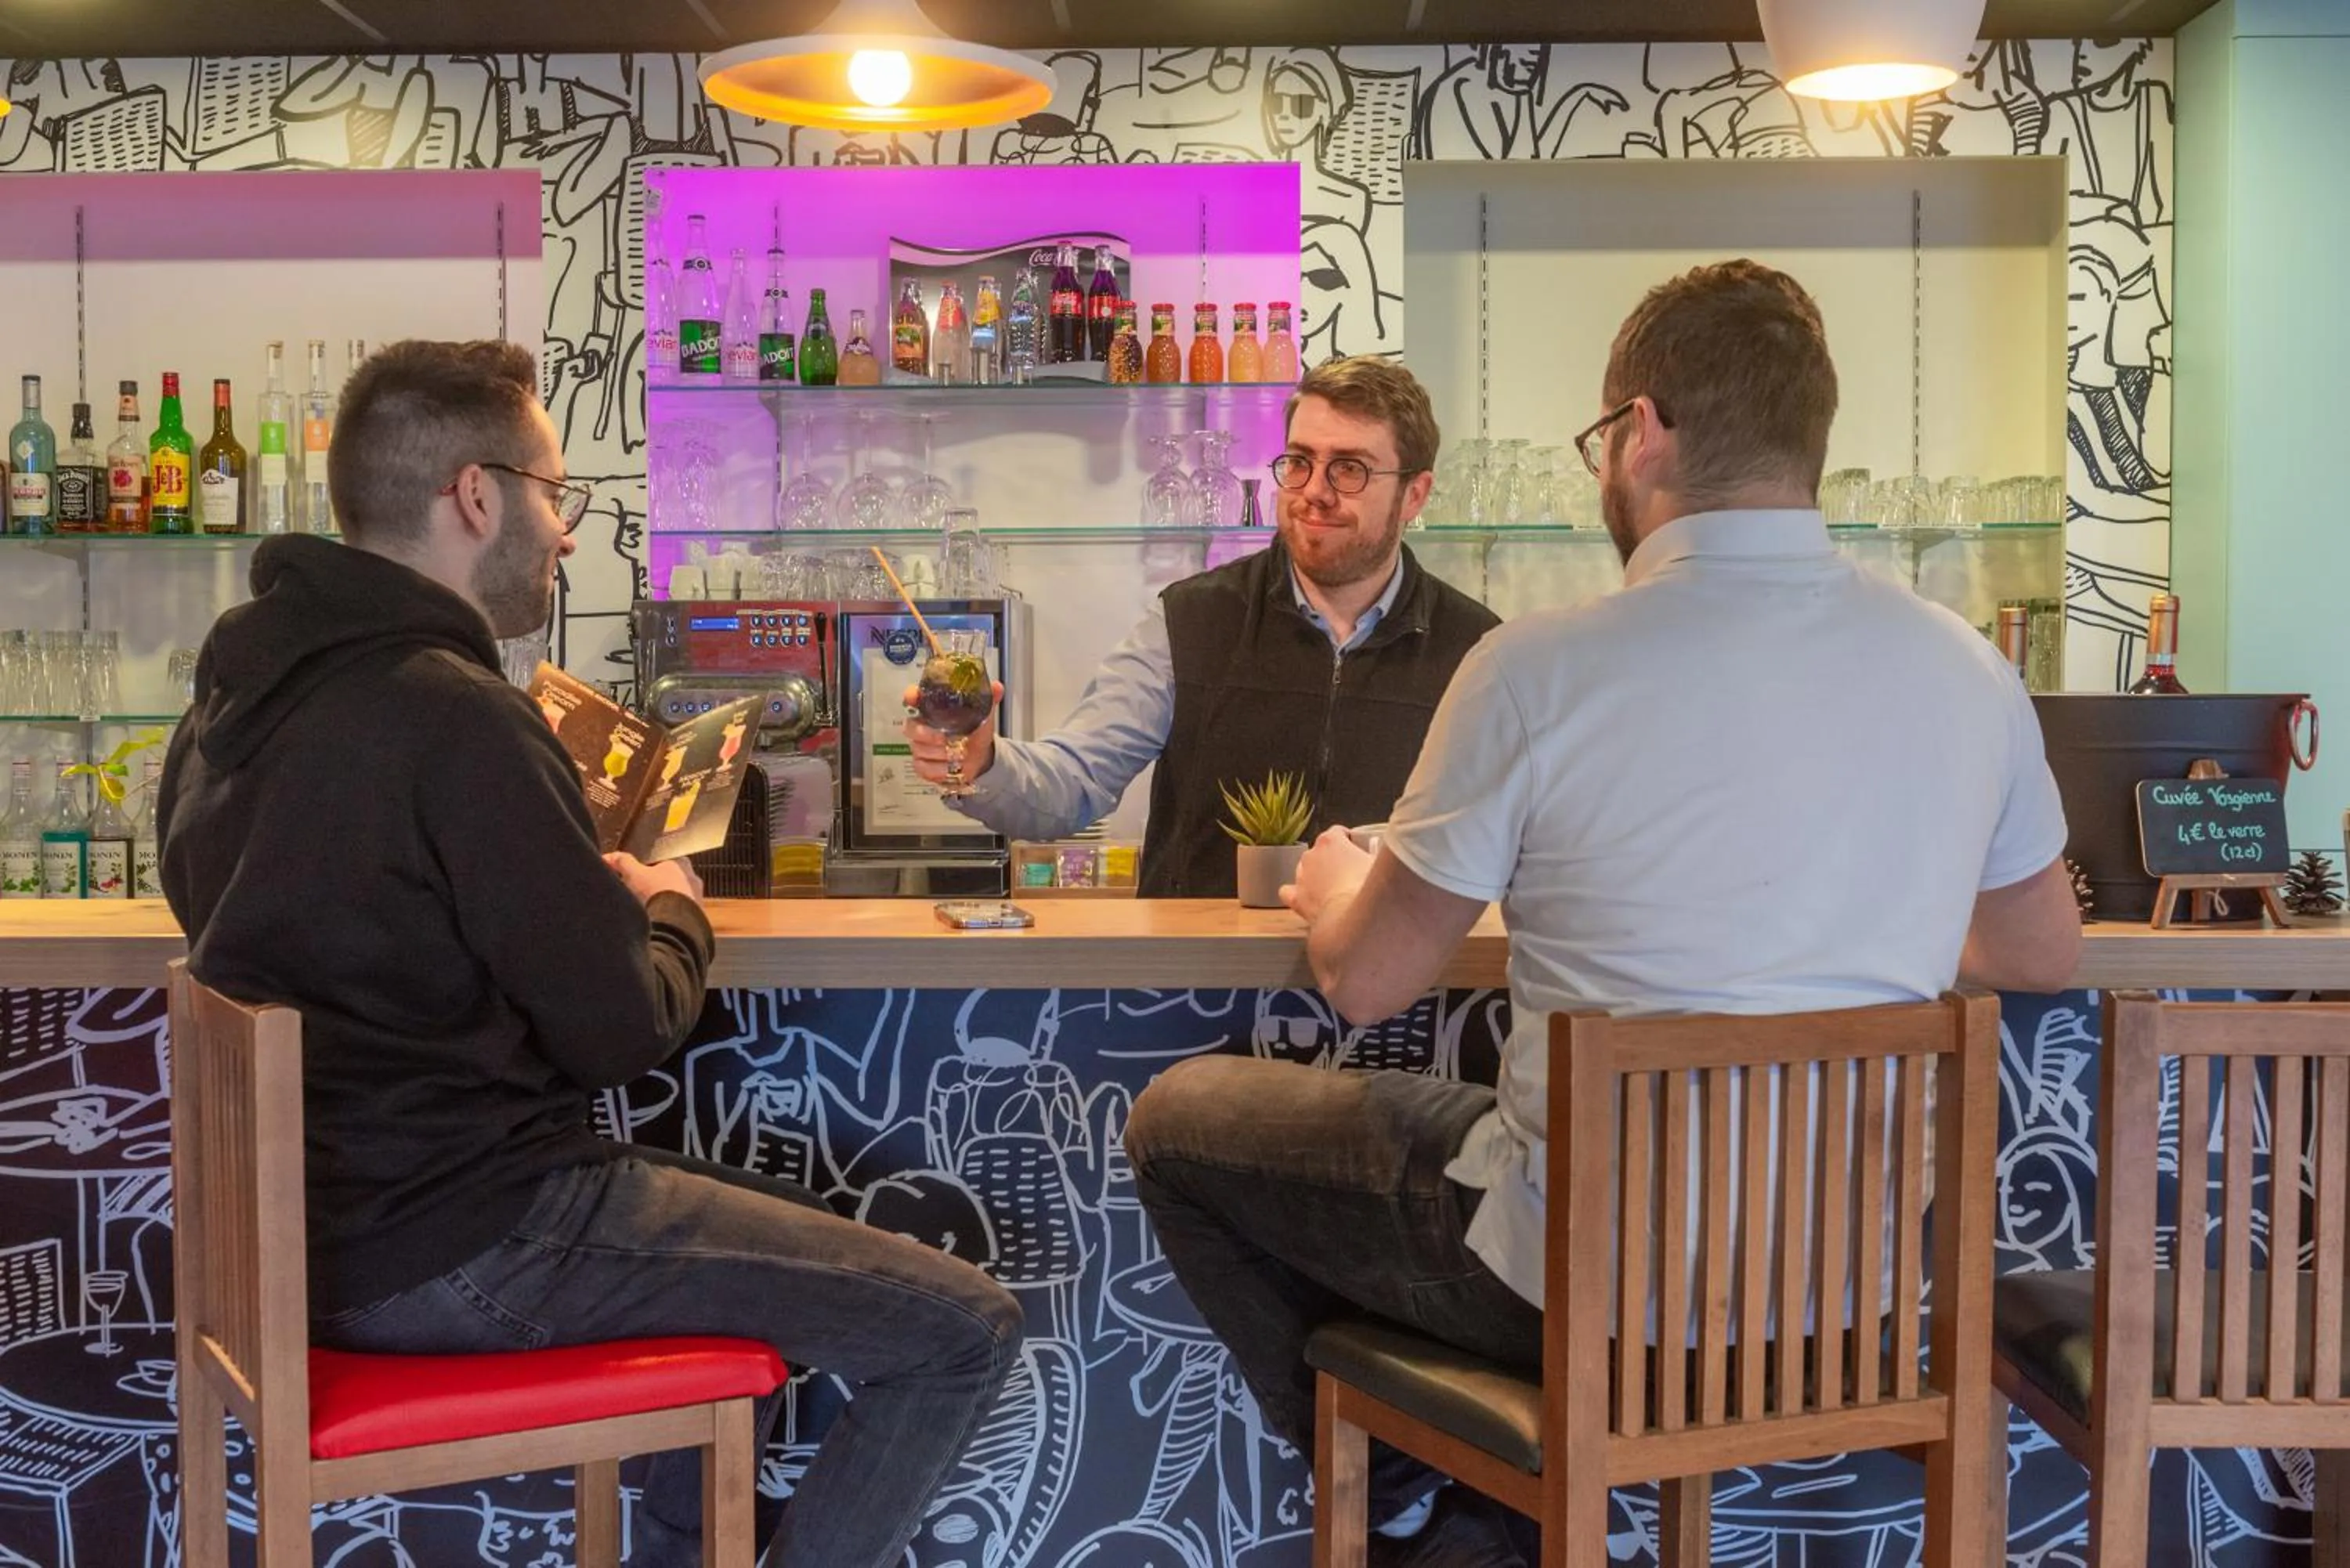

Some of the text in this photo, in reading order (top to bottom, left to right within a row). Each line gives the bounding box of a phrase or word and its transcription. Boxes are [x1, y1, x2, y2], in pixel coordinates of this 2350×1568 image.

[2153, 785, 2276, 812] Cuvée Vosgienne
[2178, 822, 2266, 845] 4€ le verre
